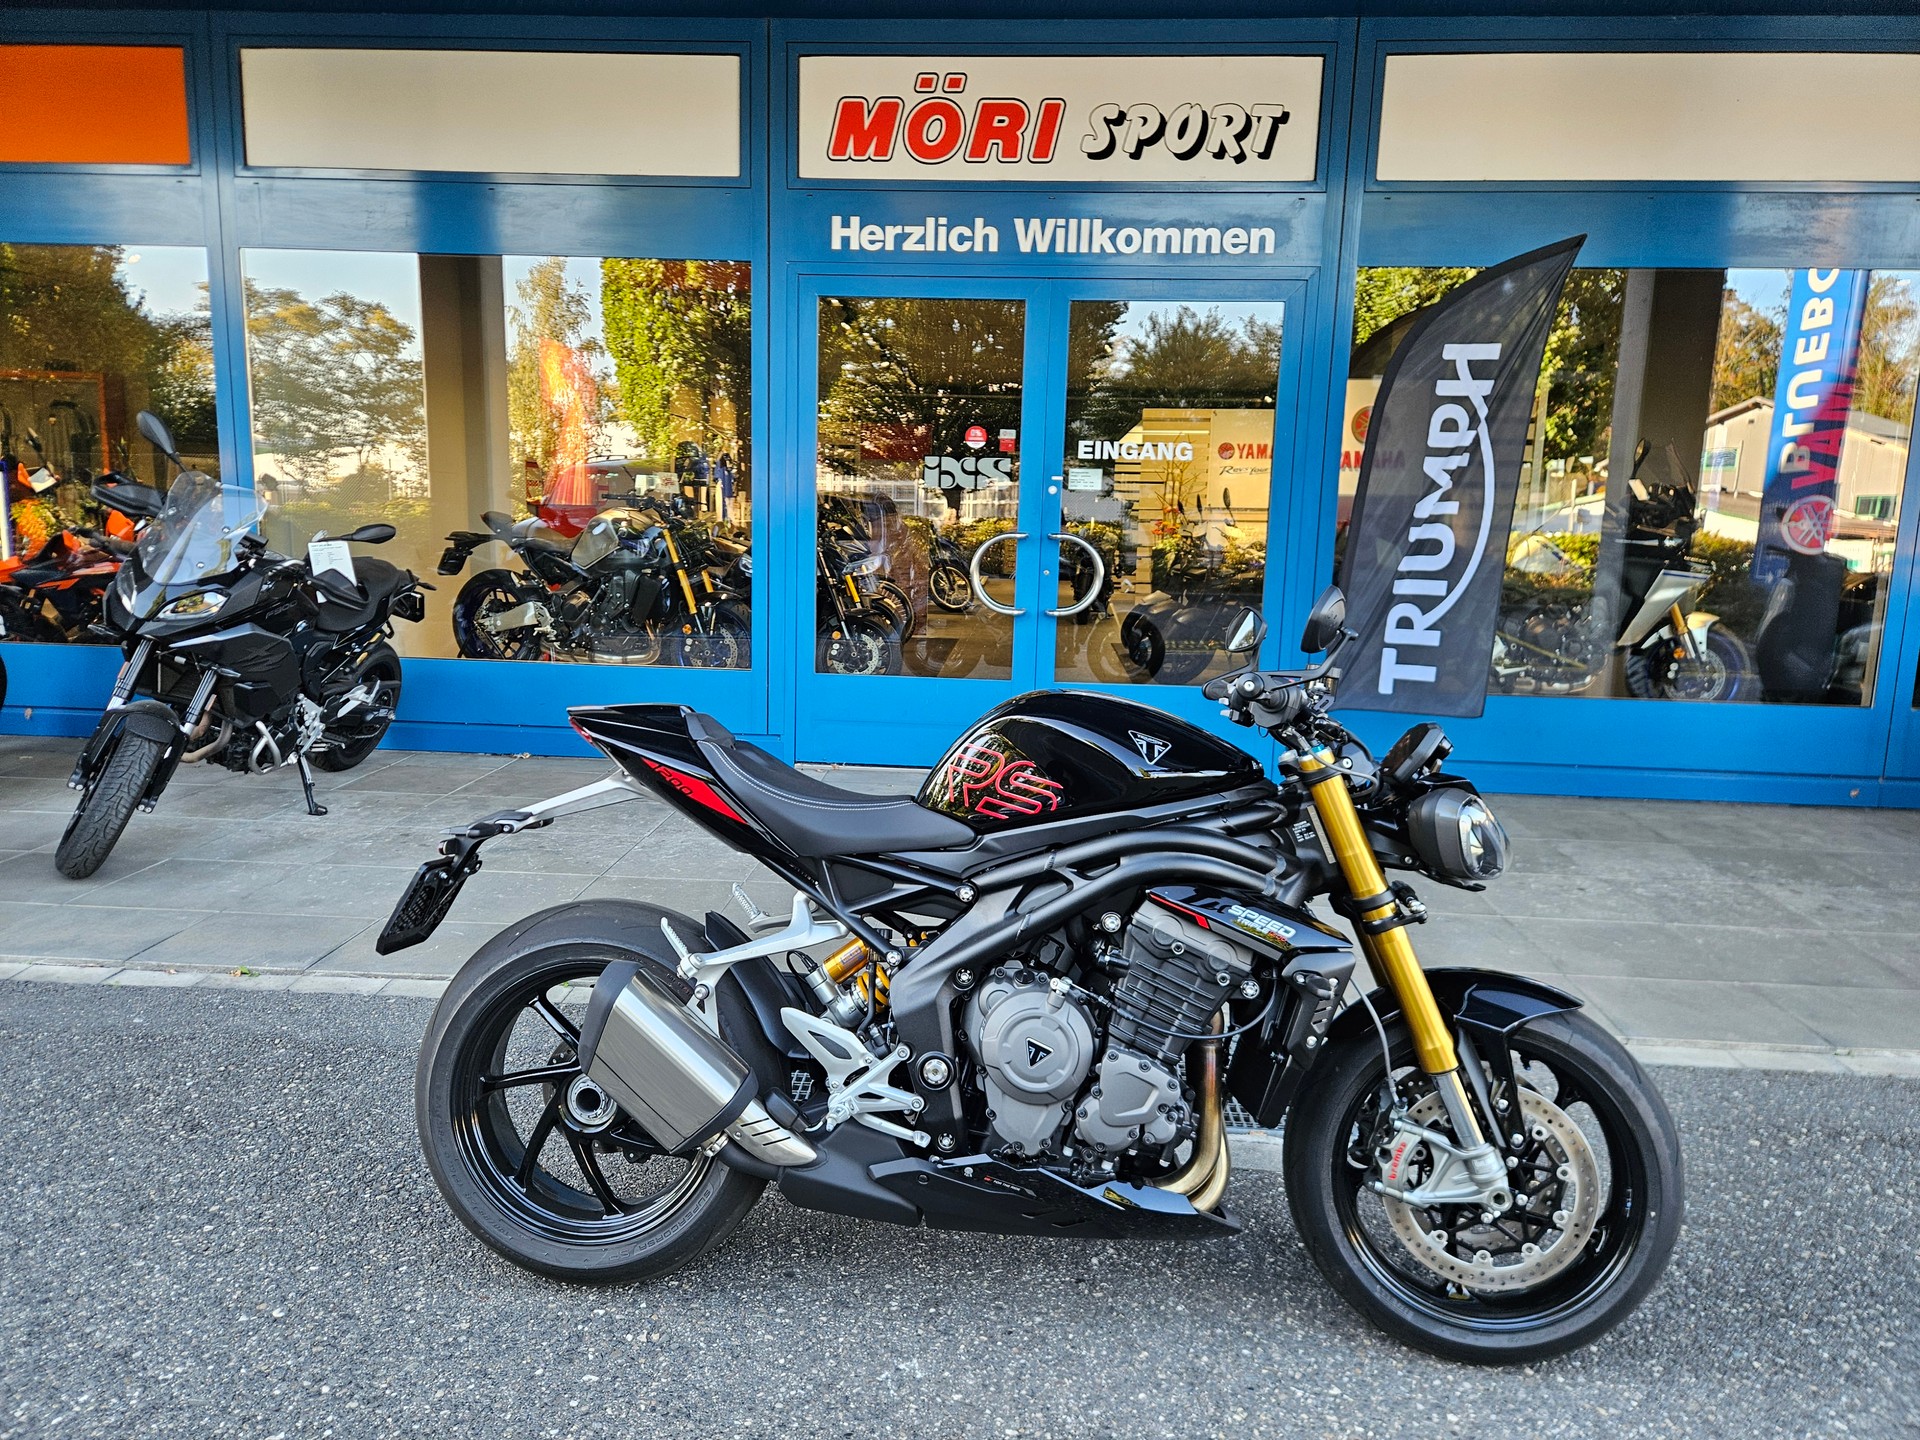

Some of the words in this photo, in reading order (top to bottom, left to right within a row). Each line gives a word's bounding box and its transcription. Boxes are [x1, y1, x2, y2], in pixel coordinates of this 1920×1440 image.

[827, 72, 1067, 165] MÖRI
[1081, 102, 1291, 165] SPORT
[830, 215, 999, 255] Herzlich
[1014, 218, 1276, 255] Willkommen
[1077, 440, 1194, 461] EINGANG
[1236, 443, 1273, 460] YAM
[1378, 342, 1502, 695] TRIUMPH
[948, 743, 1064, 820] RS
[1227, 904, 1297, 939] SPEED
[1387, 1142, 1407, 1180] brembo
[638, 1188, 712, 1252] SUPERCORSA
